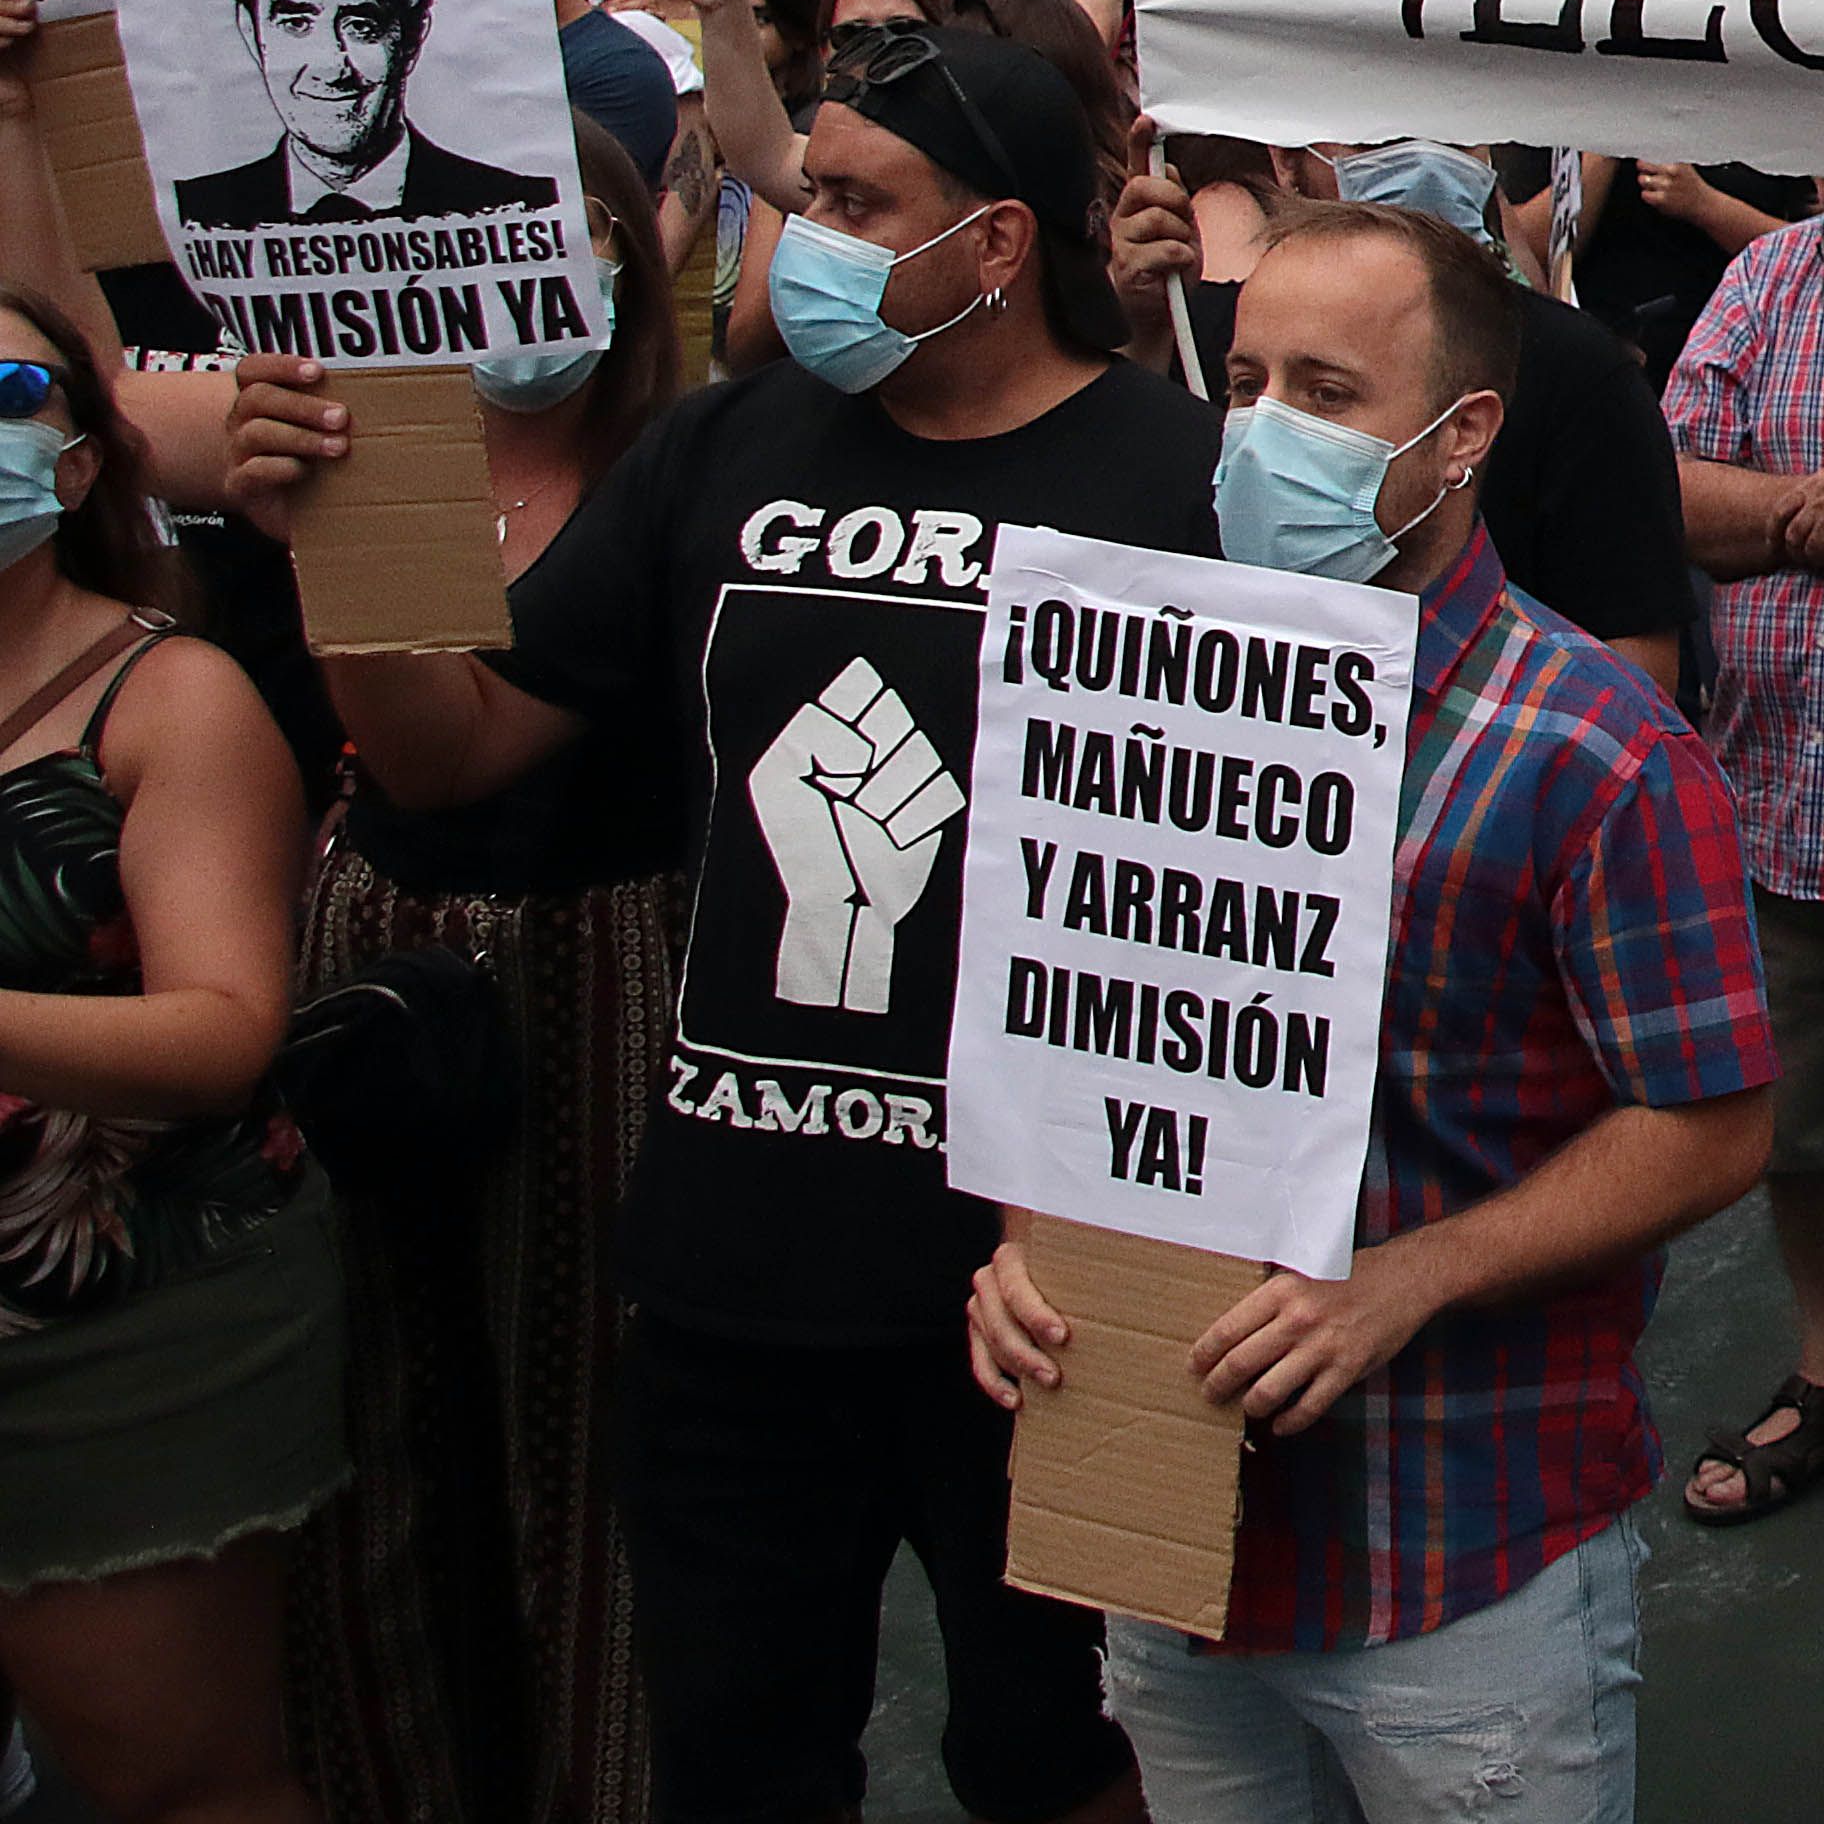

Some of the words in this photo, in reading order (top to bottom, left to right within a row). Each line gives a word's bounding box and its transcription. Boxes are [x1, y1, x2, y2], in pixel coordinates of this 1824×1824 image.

[185, 238, 255, 280] ¡HAY
[264, 220, 568, 276] RESPONSABLES!
[497, 275, 591, 346] YA
[741, 499, 992, 591] GOR
[1002, 599, 1388, 751] ¡QUIÑONES,
[1021, 717, 1355, 857] MAÑUECO
[1019, 836, 1058, 920] Y
[1063, 851, 1341, 979] ARRANZ
[1004, 955, 1331, 1099] DIMISIÓN
[667, 1055, 948, 1154] ZAMOR
[1104, 1095, 1210, 1197] YA!
